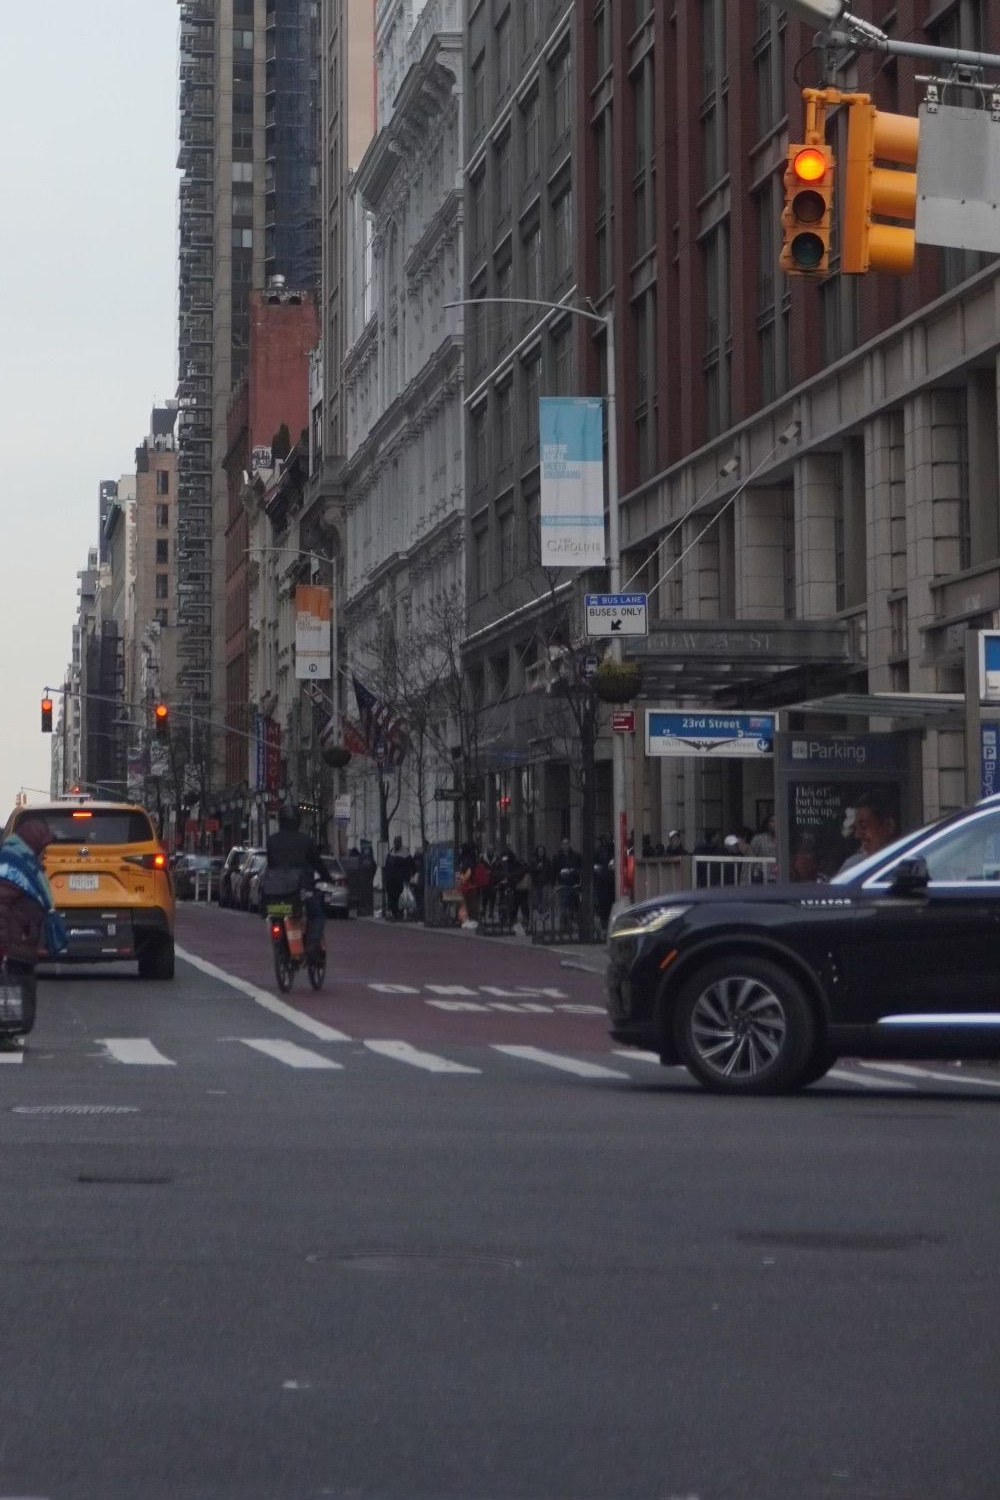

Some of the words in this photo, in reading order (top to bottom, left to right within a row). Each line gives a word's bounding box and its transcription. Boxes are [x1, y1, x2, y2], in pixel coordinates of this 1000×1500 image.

[590, 608, 617, 616] BUSES
[621, 608, 642, 616] ONLY
[682, 718, 706, 728] 23rd
[709, 718, 740, 729] Street
[809, 742, 866, 764] Parking
[795, 797, 810, 806] but
[813, 796, 823, 805] he
